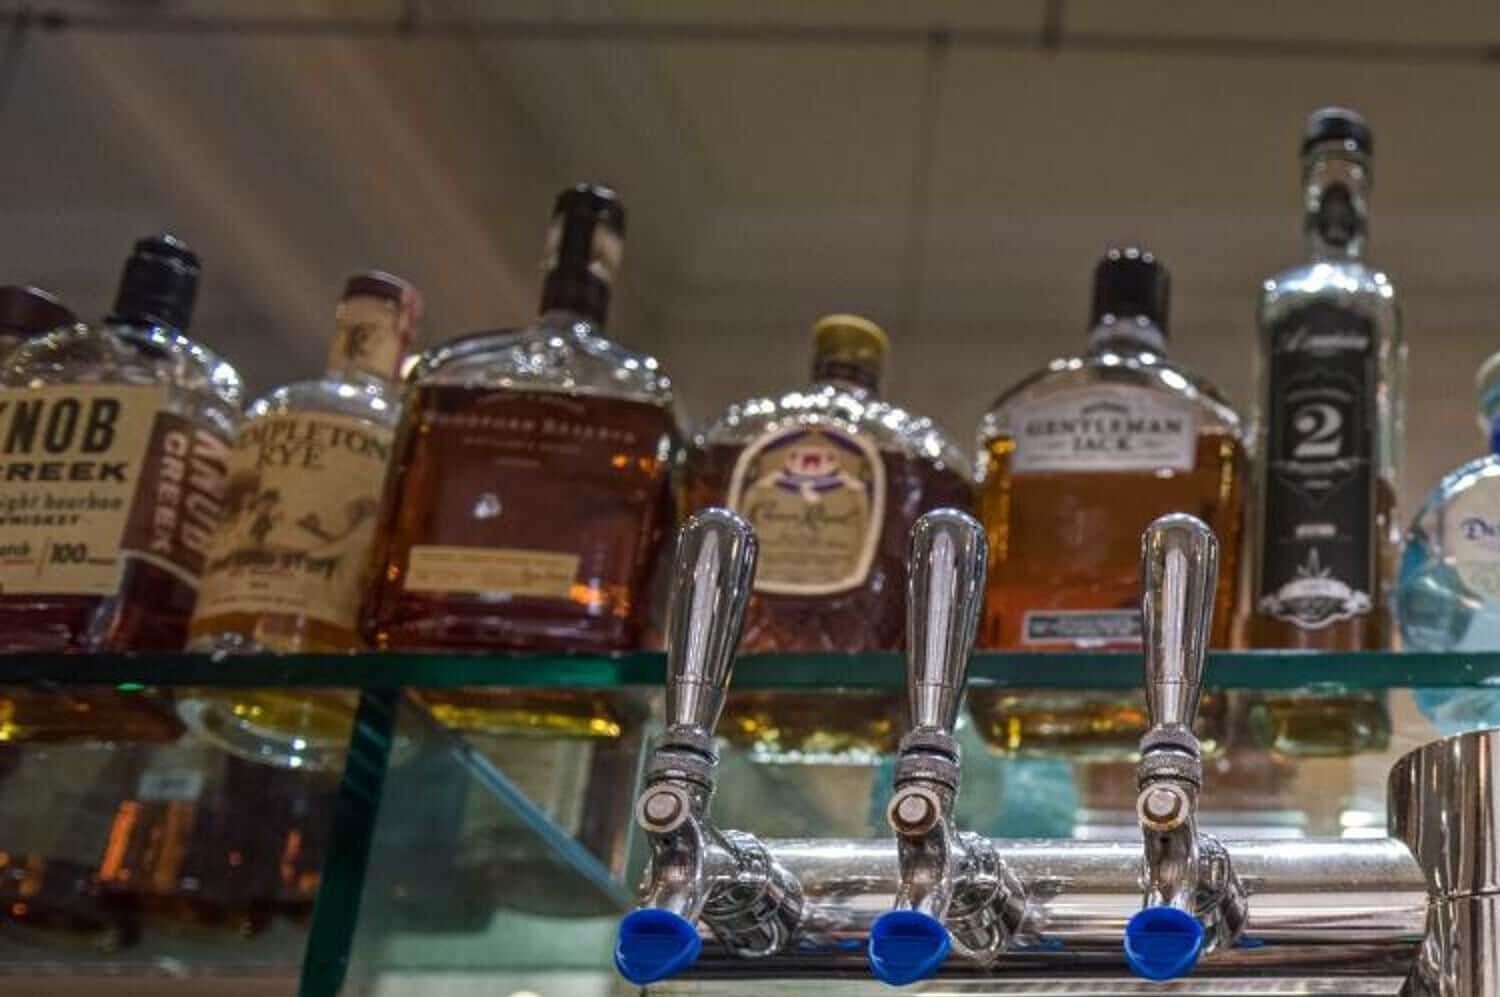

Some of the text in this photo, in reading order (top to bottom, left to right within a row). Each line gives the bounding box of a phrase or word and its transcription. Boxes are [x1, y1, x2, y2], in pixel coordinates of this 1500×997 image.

[0, 397, 121, 453] NOB
[1025, 418, 1182, 436] GENTLEMAN
[1294, 403, 1342, 456] 2
[1073, 434, 1132, 451] JACK
[257, 445, 325, 469] RYE
[0, 461, 128, 481] REEK
